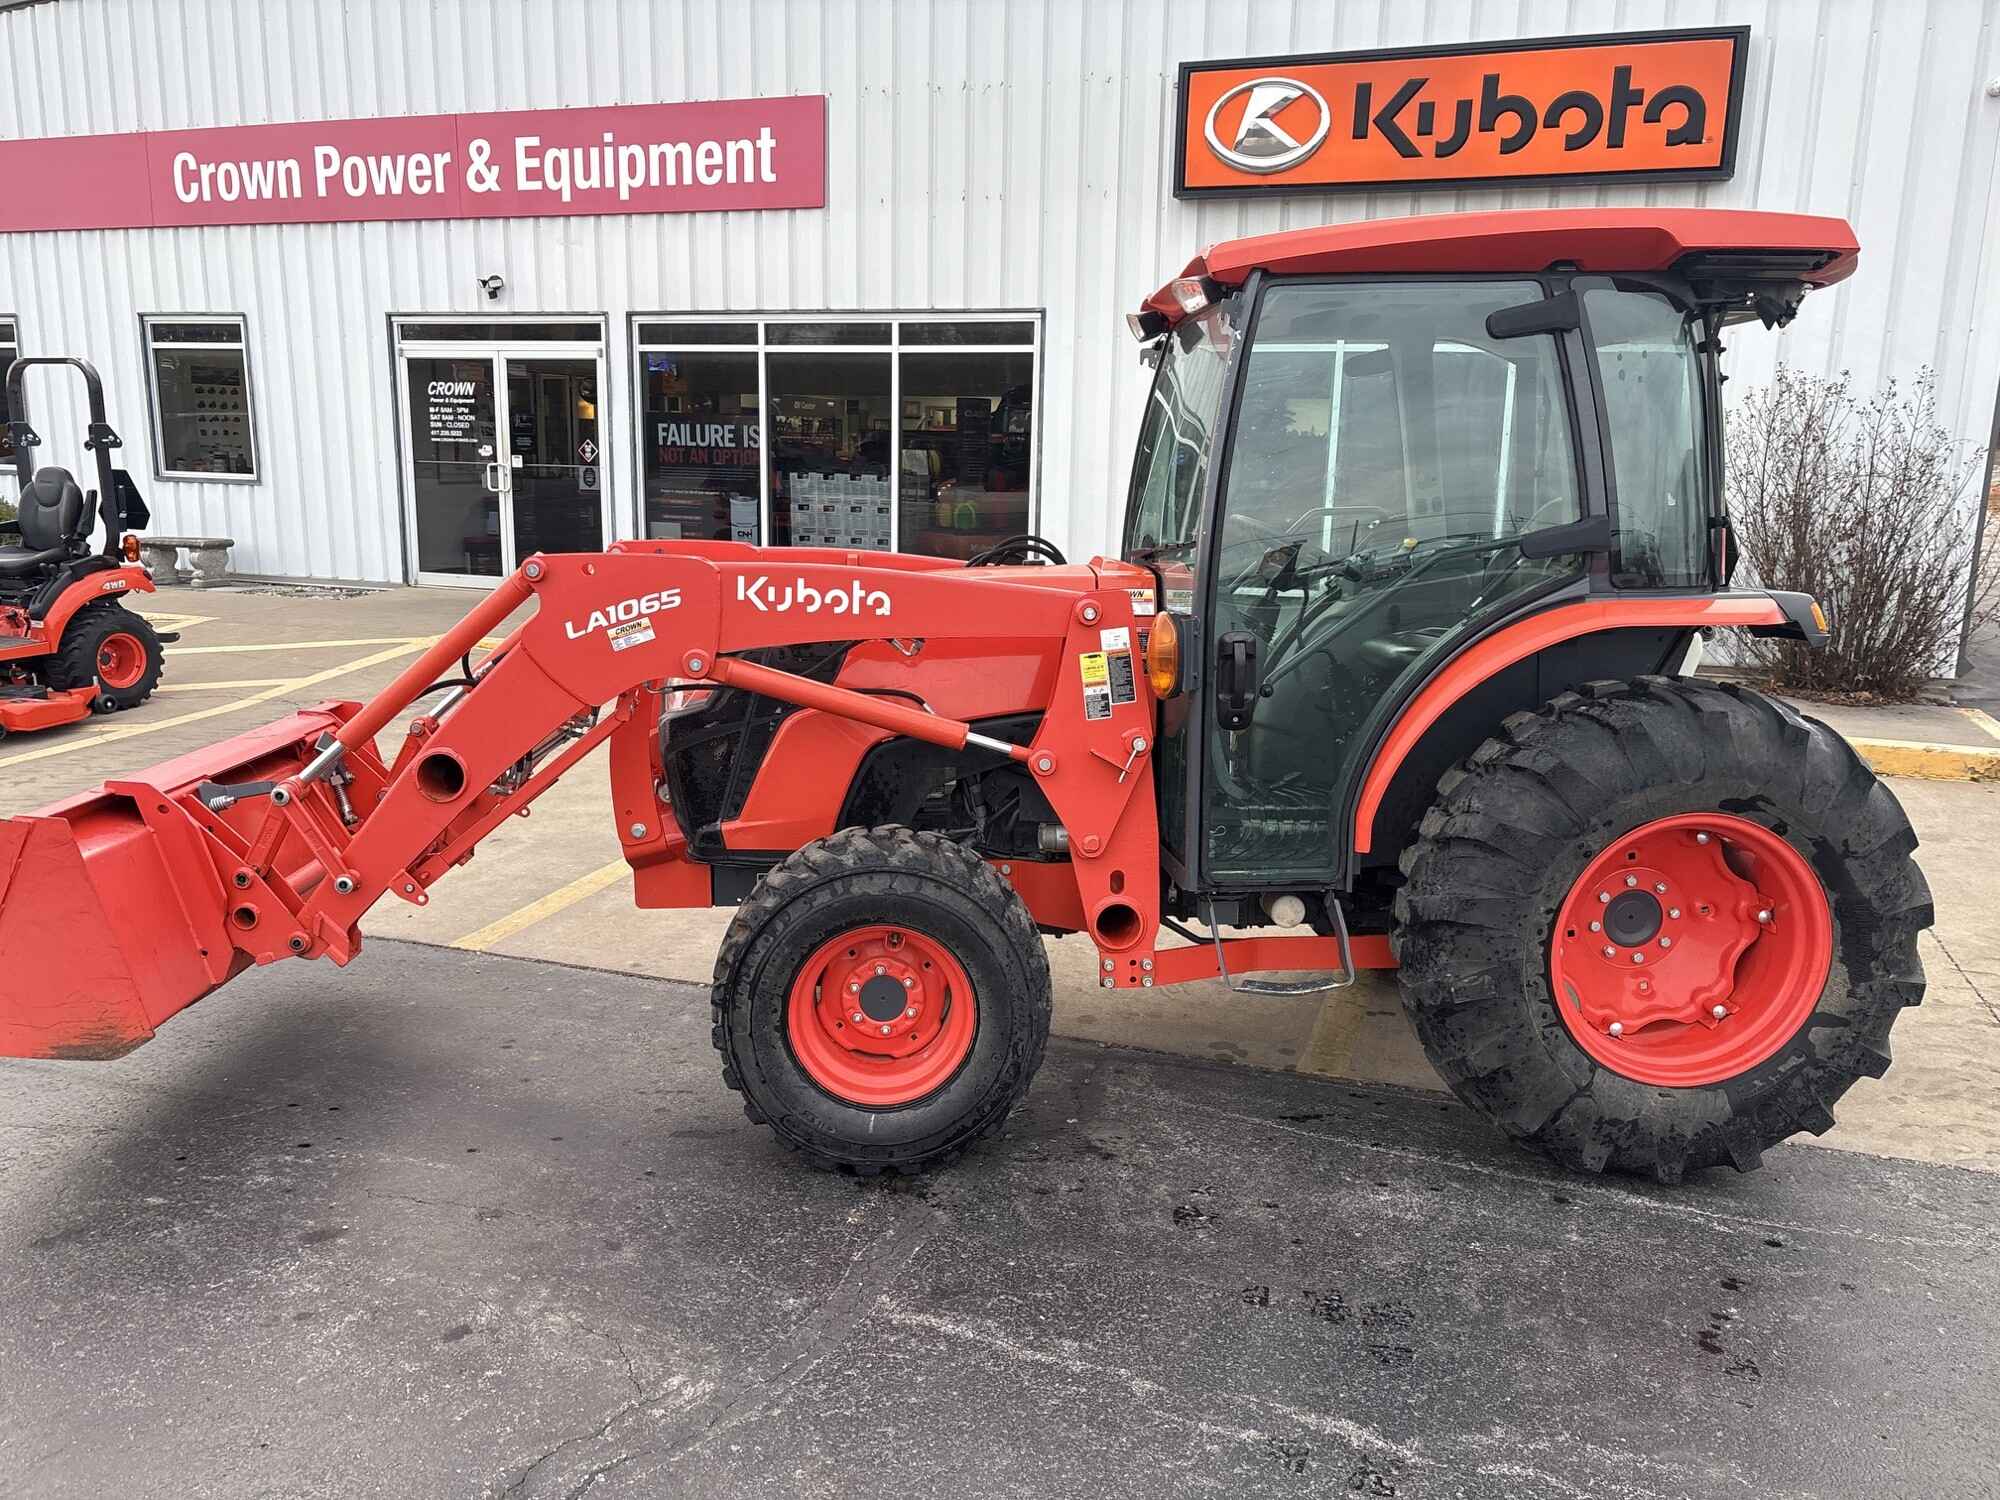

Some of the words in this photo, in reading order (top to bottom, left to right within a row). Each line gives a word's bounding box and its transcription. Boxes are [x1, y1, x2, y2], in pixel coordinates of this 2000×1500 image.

[1350, 64, 1706, 159] Kubota
[172, 150, 302, 204] Crown
[314, 143, 453, 199] Power
[465, 137, 502, 193] &
[514, 126, 777, 203] Equipment
[427, 381, 476, 396] CROWN
[657, 423, 737, 449] FAILURE
[743, 425, 760, 449] IS
[659, 448, 686, 464] NOT
[689, 448, 708, 464] AN
[102, 579, 126, 590] 4WD
[737, 575, 892, 616] Kubota
[565, 587, 682, 640] LA1065
[615, 620, 642, 636] CROWN
